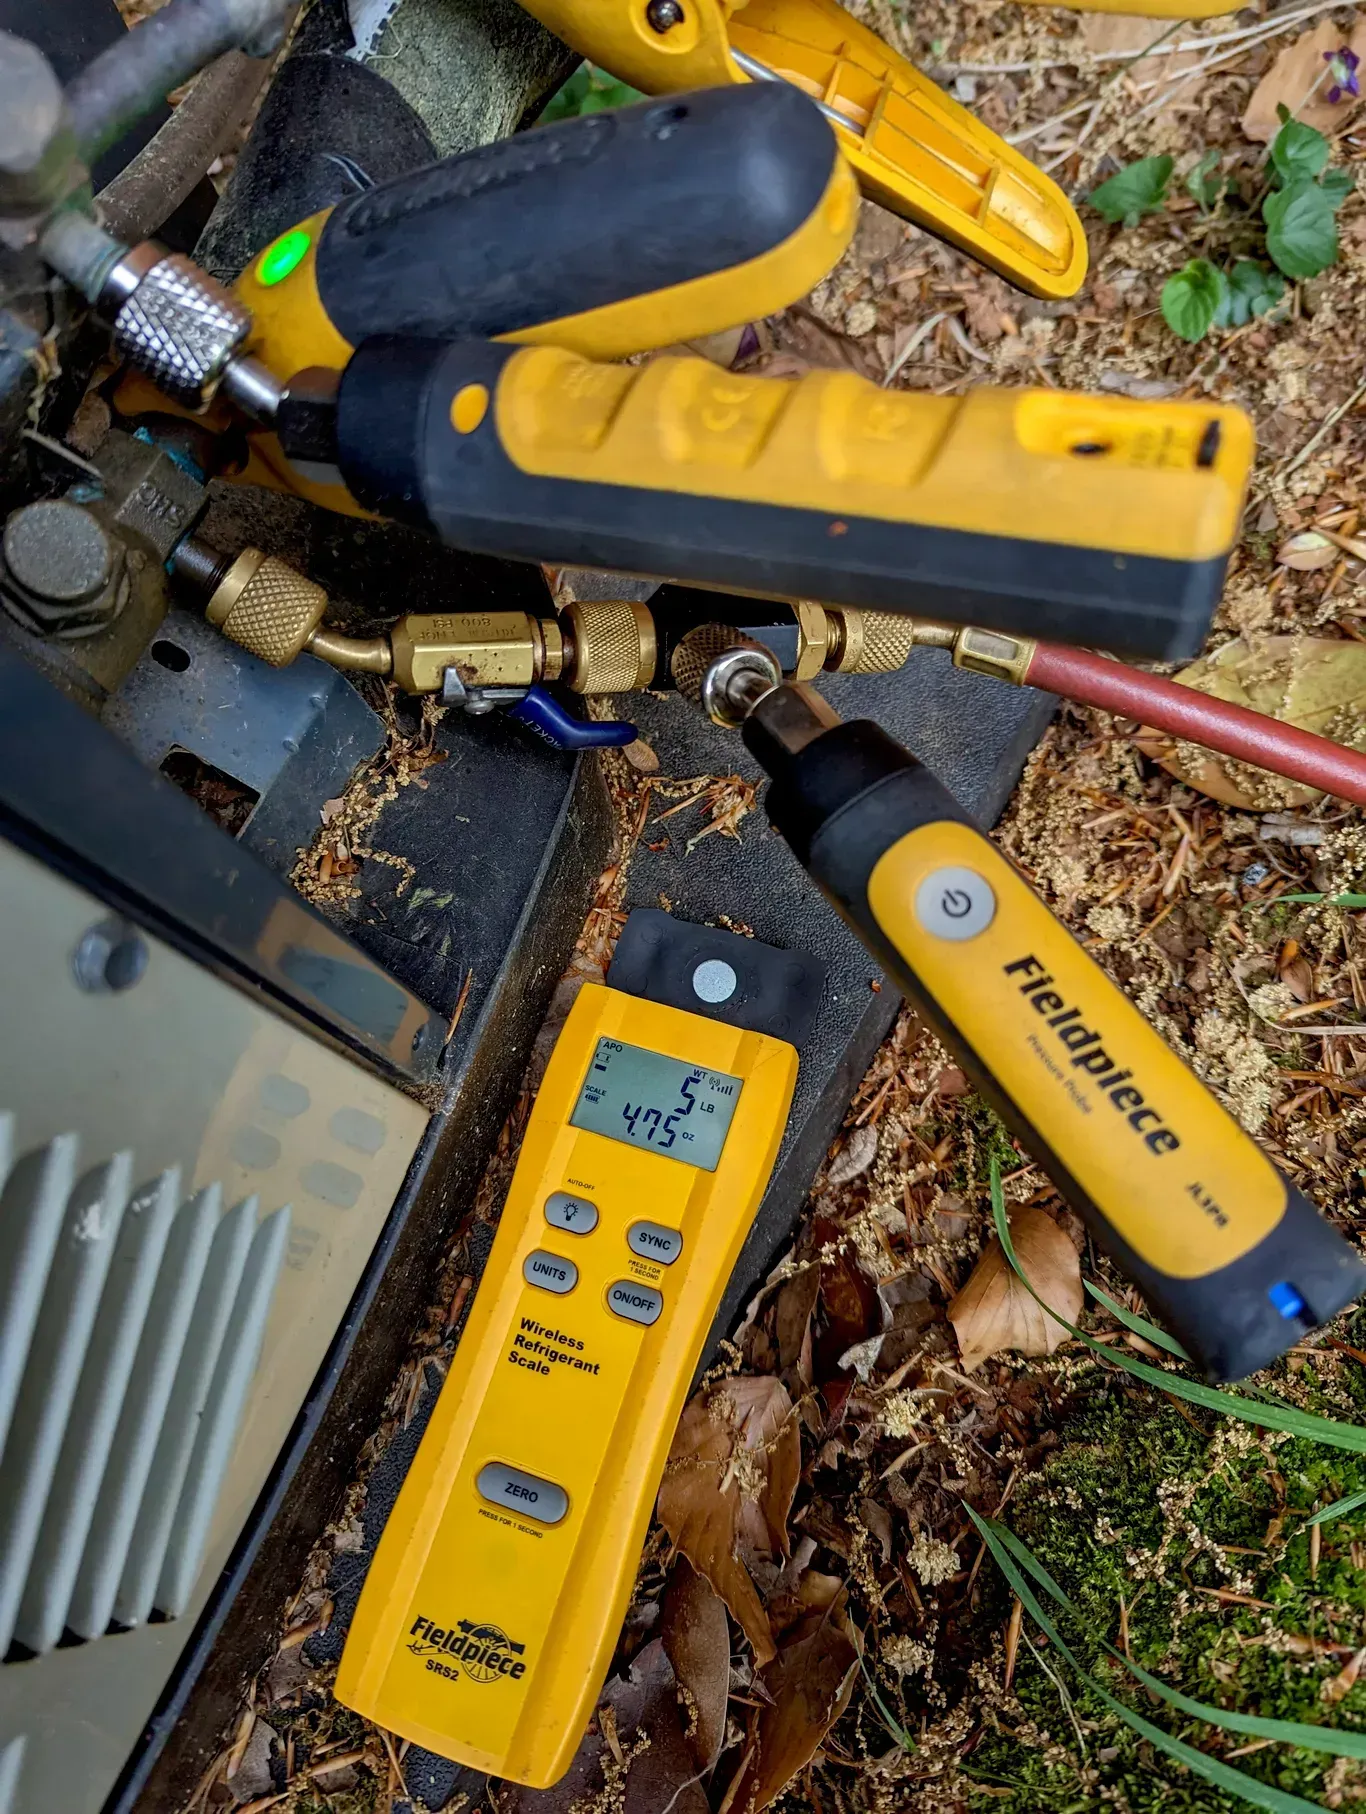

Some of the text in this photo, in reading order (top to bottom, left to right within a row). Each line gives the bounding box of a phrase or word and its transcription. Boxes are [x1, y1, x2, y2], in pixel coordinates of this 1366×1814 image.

[432, 617, 491, 628] 800 PSI
[603, 1041, 623, 1052] APO
[1003, 953, 1181, 1156] Fieldpiece
[693, 1068, 708, 1079] WT
[585, 1084, 607, 1096] SCALE
[674, 1075, 715, 1115] 5 LB
[622, 1102, 681, 1148] 4.75
[567, 1178, 596, 1191] AUTO-OFF
[639, 1232, 671, 1250] SYNC
[532, 1261, 567, 1281] UNITS
[628, 1259, 661, 1275] PRESS FOR
[634, 1267, 659, 1280] SECOND
[613, 1289, 655, 1311] ON/OFF
[520, 1316, 585, 1351] Wireless
[508, 1350, 551, 1375] Scale
[514, 1333, 601, 1375] Refrigerant
[504, 1482, 539, 1503] ZERO
[478, 1508, 498, 1521] PRESS
[499, 1516, 512, 1527] FOR
[517, 1524, 543, 1539] SECOND
[409, 1613, 526, 1680] Fieldpiece
[425, 1658, 460, 1682] SRS2
